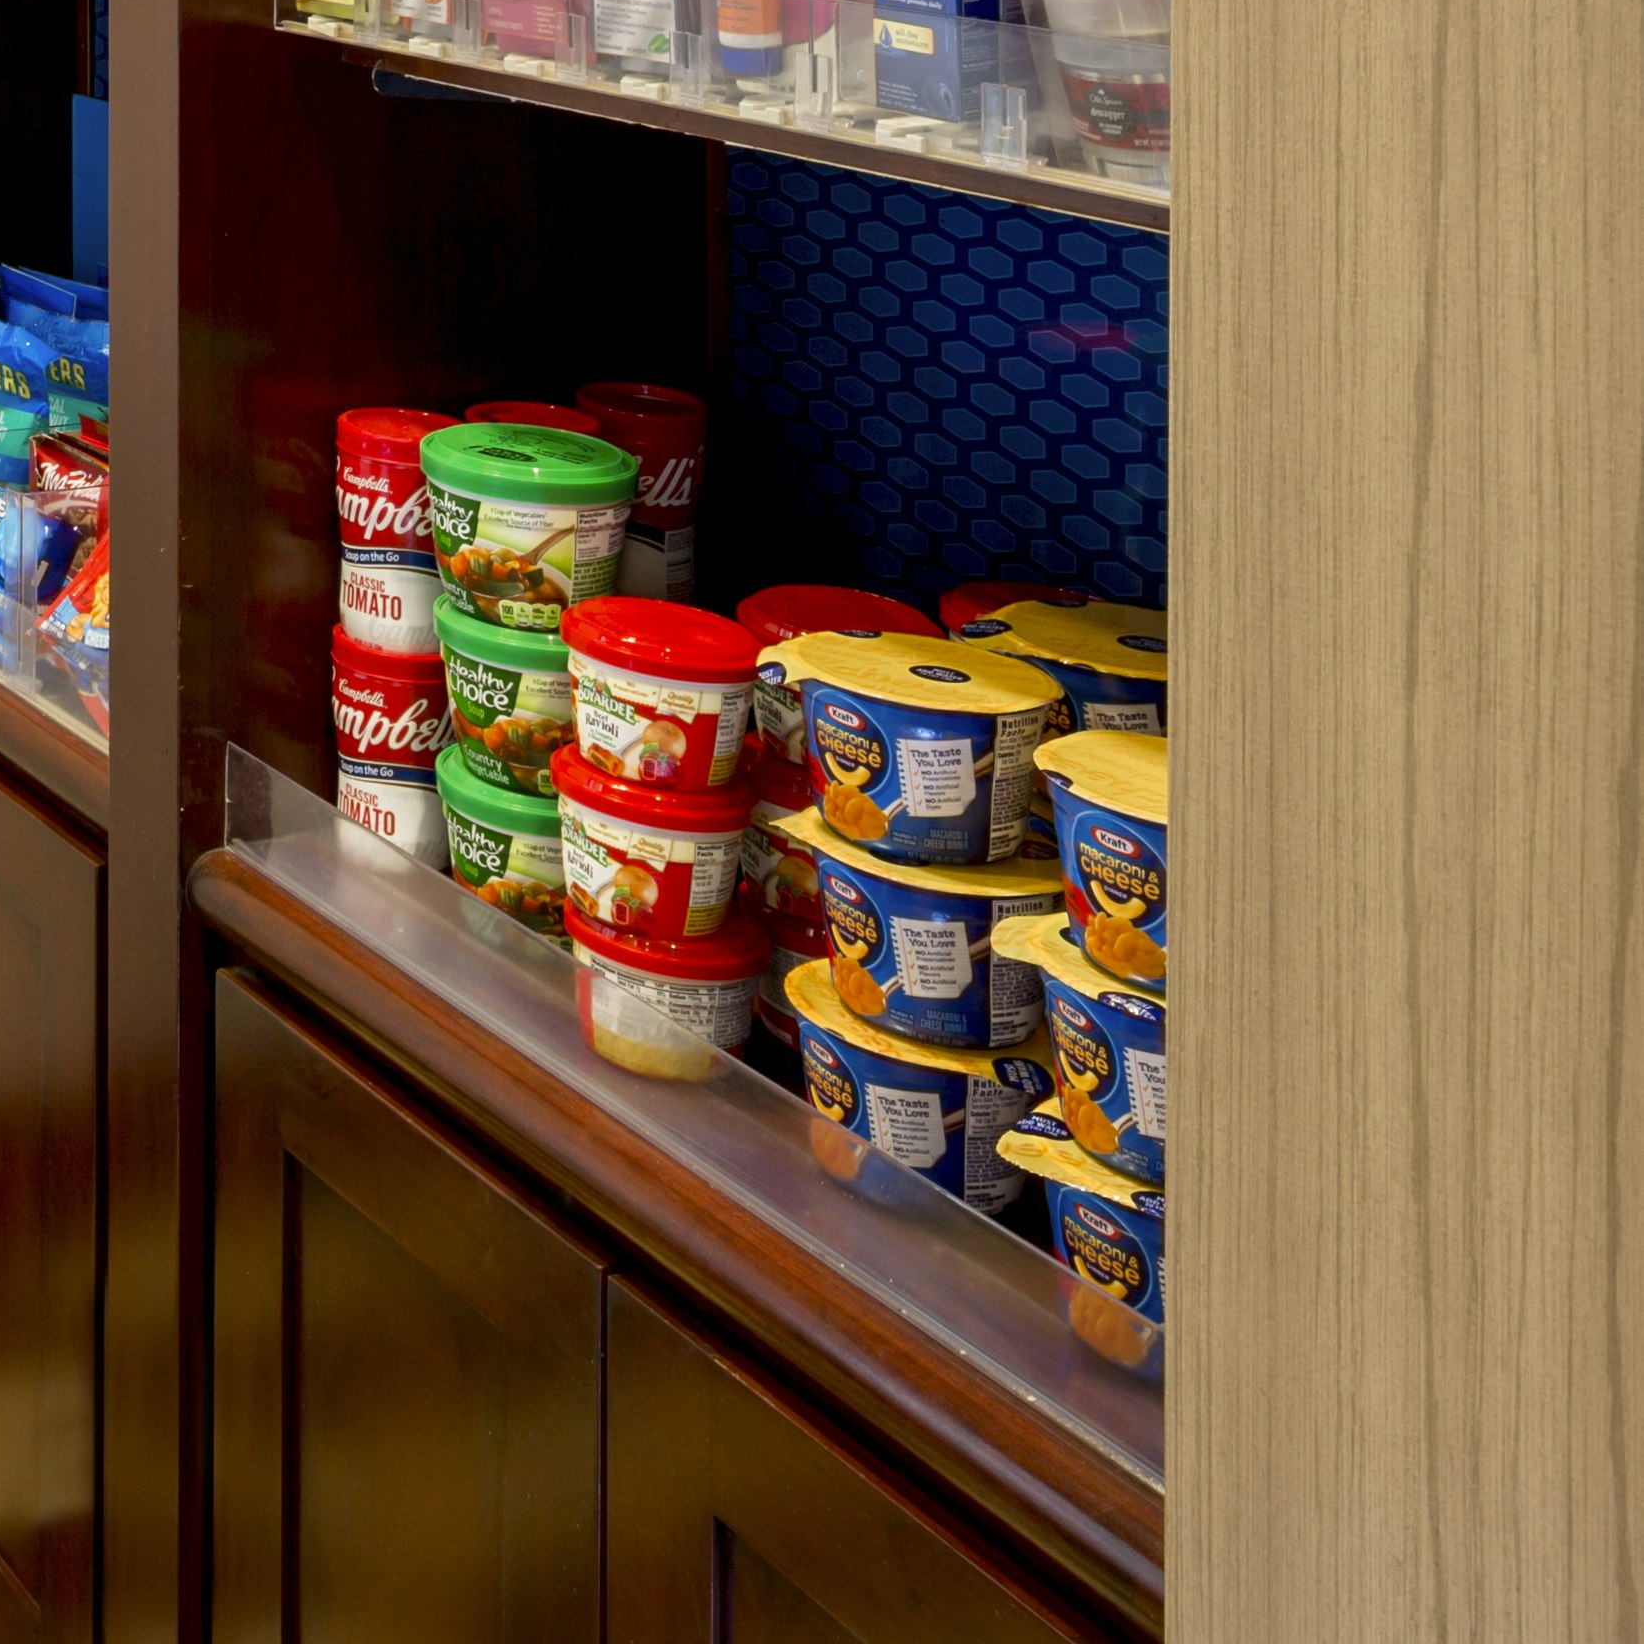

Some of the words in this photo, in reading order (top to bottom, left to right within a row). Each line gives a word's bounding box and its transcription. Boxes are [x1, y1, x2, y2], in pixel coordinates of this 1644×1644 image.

[343, 466, 390, 493] Campbell's
[432, 508, 473, 540] hoice
[345, 549, 360, 562] Soup
[360, 554, 369, 562] on
[370, 552, 384, 562] the
[385, 551, 400, 562] Go
[350, 571, 386, 593] CLASSIC
[342, 579, 403, 621] TOMATO
[449, 655, 514, 693] Healthy
[338, 678, 385, 707] Campbell's
[449, 668, 510, 712] Choice
[578, 685, 637, 725] BOYARDEE
[831, 706, 854, 724] Kraft
[1097, 712, 1116, 722] The
[1118, 712, 1148, 721] Taste
[585, 713, 620, 739] Ravioli
[816, 717, 870, 749] macaroni
[1001, 717, 1039, 730] Nutrition
[1102, 722, 1121, 731] You
[1123, 722, 1148, 731] Love
[910, 748, 928, 758] The
[931, 748, 961, 757] Taste
[915, 758, 936, 768] You
[939, 758, 962, 767] Love
[364, 764, 378, 776] the
[380, 765, 394, 778] Go
[345, 782, 379, 807] CLASSIC
[339, 789, 396, 836] TOMATO
[447, 812, 505, 855] Healthy
[1099, 832, 1127, 852] Kraft
[447, 828, 502, 873] Choice
[1079, 841, 1145, 880] macaroni
[832, 880, 853, 898] Kraft
[903, 928, 922, 938] The
[926, 929, 956, 939] Taste
[909, 938, 928, 948] You
[930, 939, 956, 948] Love
[1082, 1210, 1109, 1233] Kraft
[1064, 1214, 1126, 1259] macaroni
